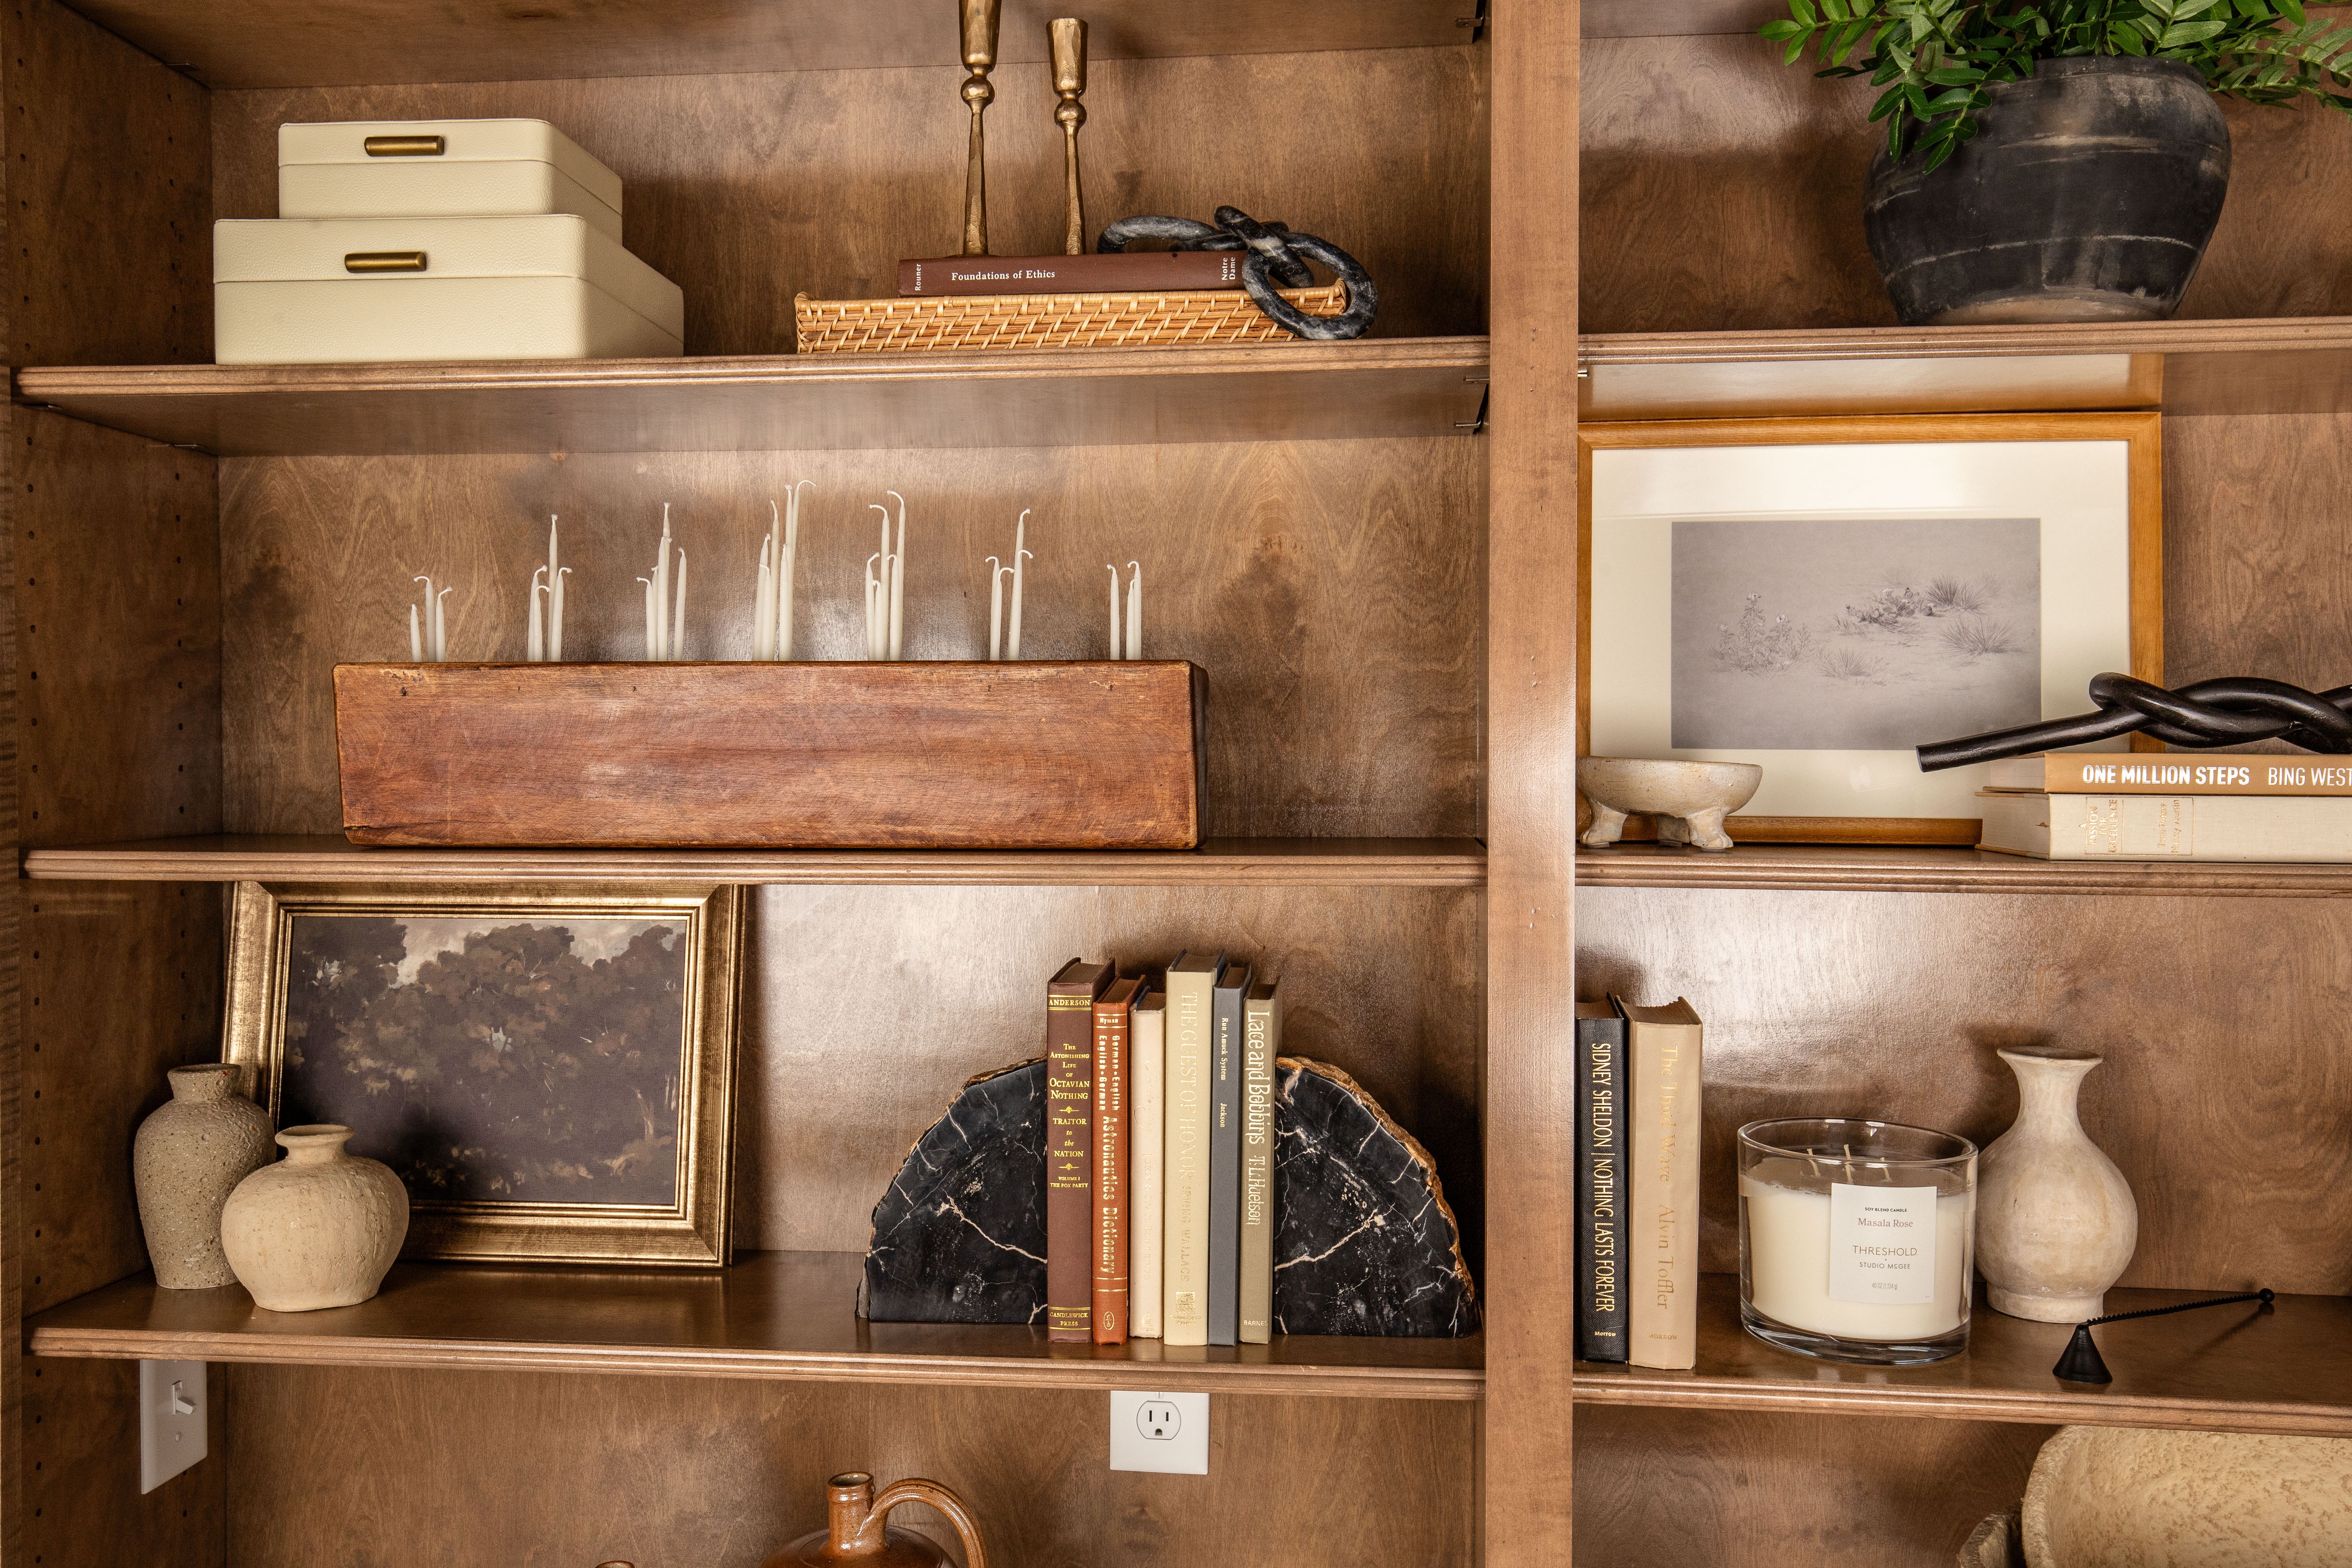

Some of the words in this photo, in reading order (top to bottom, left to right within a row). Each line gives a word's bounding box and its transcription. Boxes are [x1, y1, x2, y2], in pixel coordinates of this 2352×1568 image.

[951, 271, 1009, 281] Foundations
[1013, 270, 1022, 279] of
[1026, 270, 1055, 278] Ethics
[2082, 765, 2117, 784] ONE
[2121, 765, 2190, 784] MILLION
[2195, 766, 2250, 785] STEPS
[2268, 767, 2305, 786] BING
[2310, 768, 2352, 786] WEST
[2089, 806, 2098, 845] PASSION
[2099, 816, 2108, 835] FOR
[2108, 799, 2118, 853] EXCELLENCE
[2159, 803, 2167, 827] Peters
[2158, 830, 2167, 848] Tom
[2171, 828, 2182, 853] Nancy
[1181, 992, 1197, 1026] THE
[1247, 1010, 1270, 1049] Lace
[1180, 1030, 1197, 1087] GUEST
[1219, 1057, 1228, 1080] System
[1245, 1051, 1270, 1081] and
[1591, 1043, 1611, 1085] SIDNEY
[1662, 1045, 1678, 1076] The
[1179, 1090, 1196, 1114] OF
[1245, 1084, 1270, 1145] Bobbins
[1592, 1090, 1613, 1147] SHELDON
[1660, 1081, 1677, 1127] Third
[1103, 1116, 1118, 1200] Astronautics
[1143, 1153, 1152, 1180] JOHN
[1179, 1118, 1196, 1179] HONOR
[1659, 1134, 1676, 1181] Wave
[1181, 1186, 1191, 1223] IRVING
[1245, 1178, 1265, 1225] Huetson
[1594, 1159, 1614, 1217] NOTHING
[1100, 1207, 1118, 1274] Dictionary
[1595, 1223, 1614, 1256] LASTS
[1659, 1204, 1675, 1249] Alvin
[1858, 1218, 1891, 1227] Masala
[1893, 1219, 1913, 1227] Rose
[1180, 1229, 1191, 1281] WALLACE
[1853, 1245, 1917, 1256] THRESHOLD
[1595, 1260, 1615, 1312] FOREVER
[1657, 1256, 1674, 1309] Toffler
